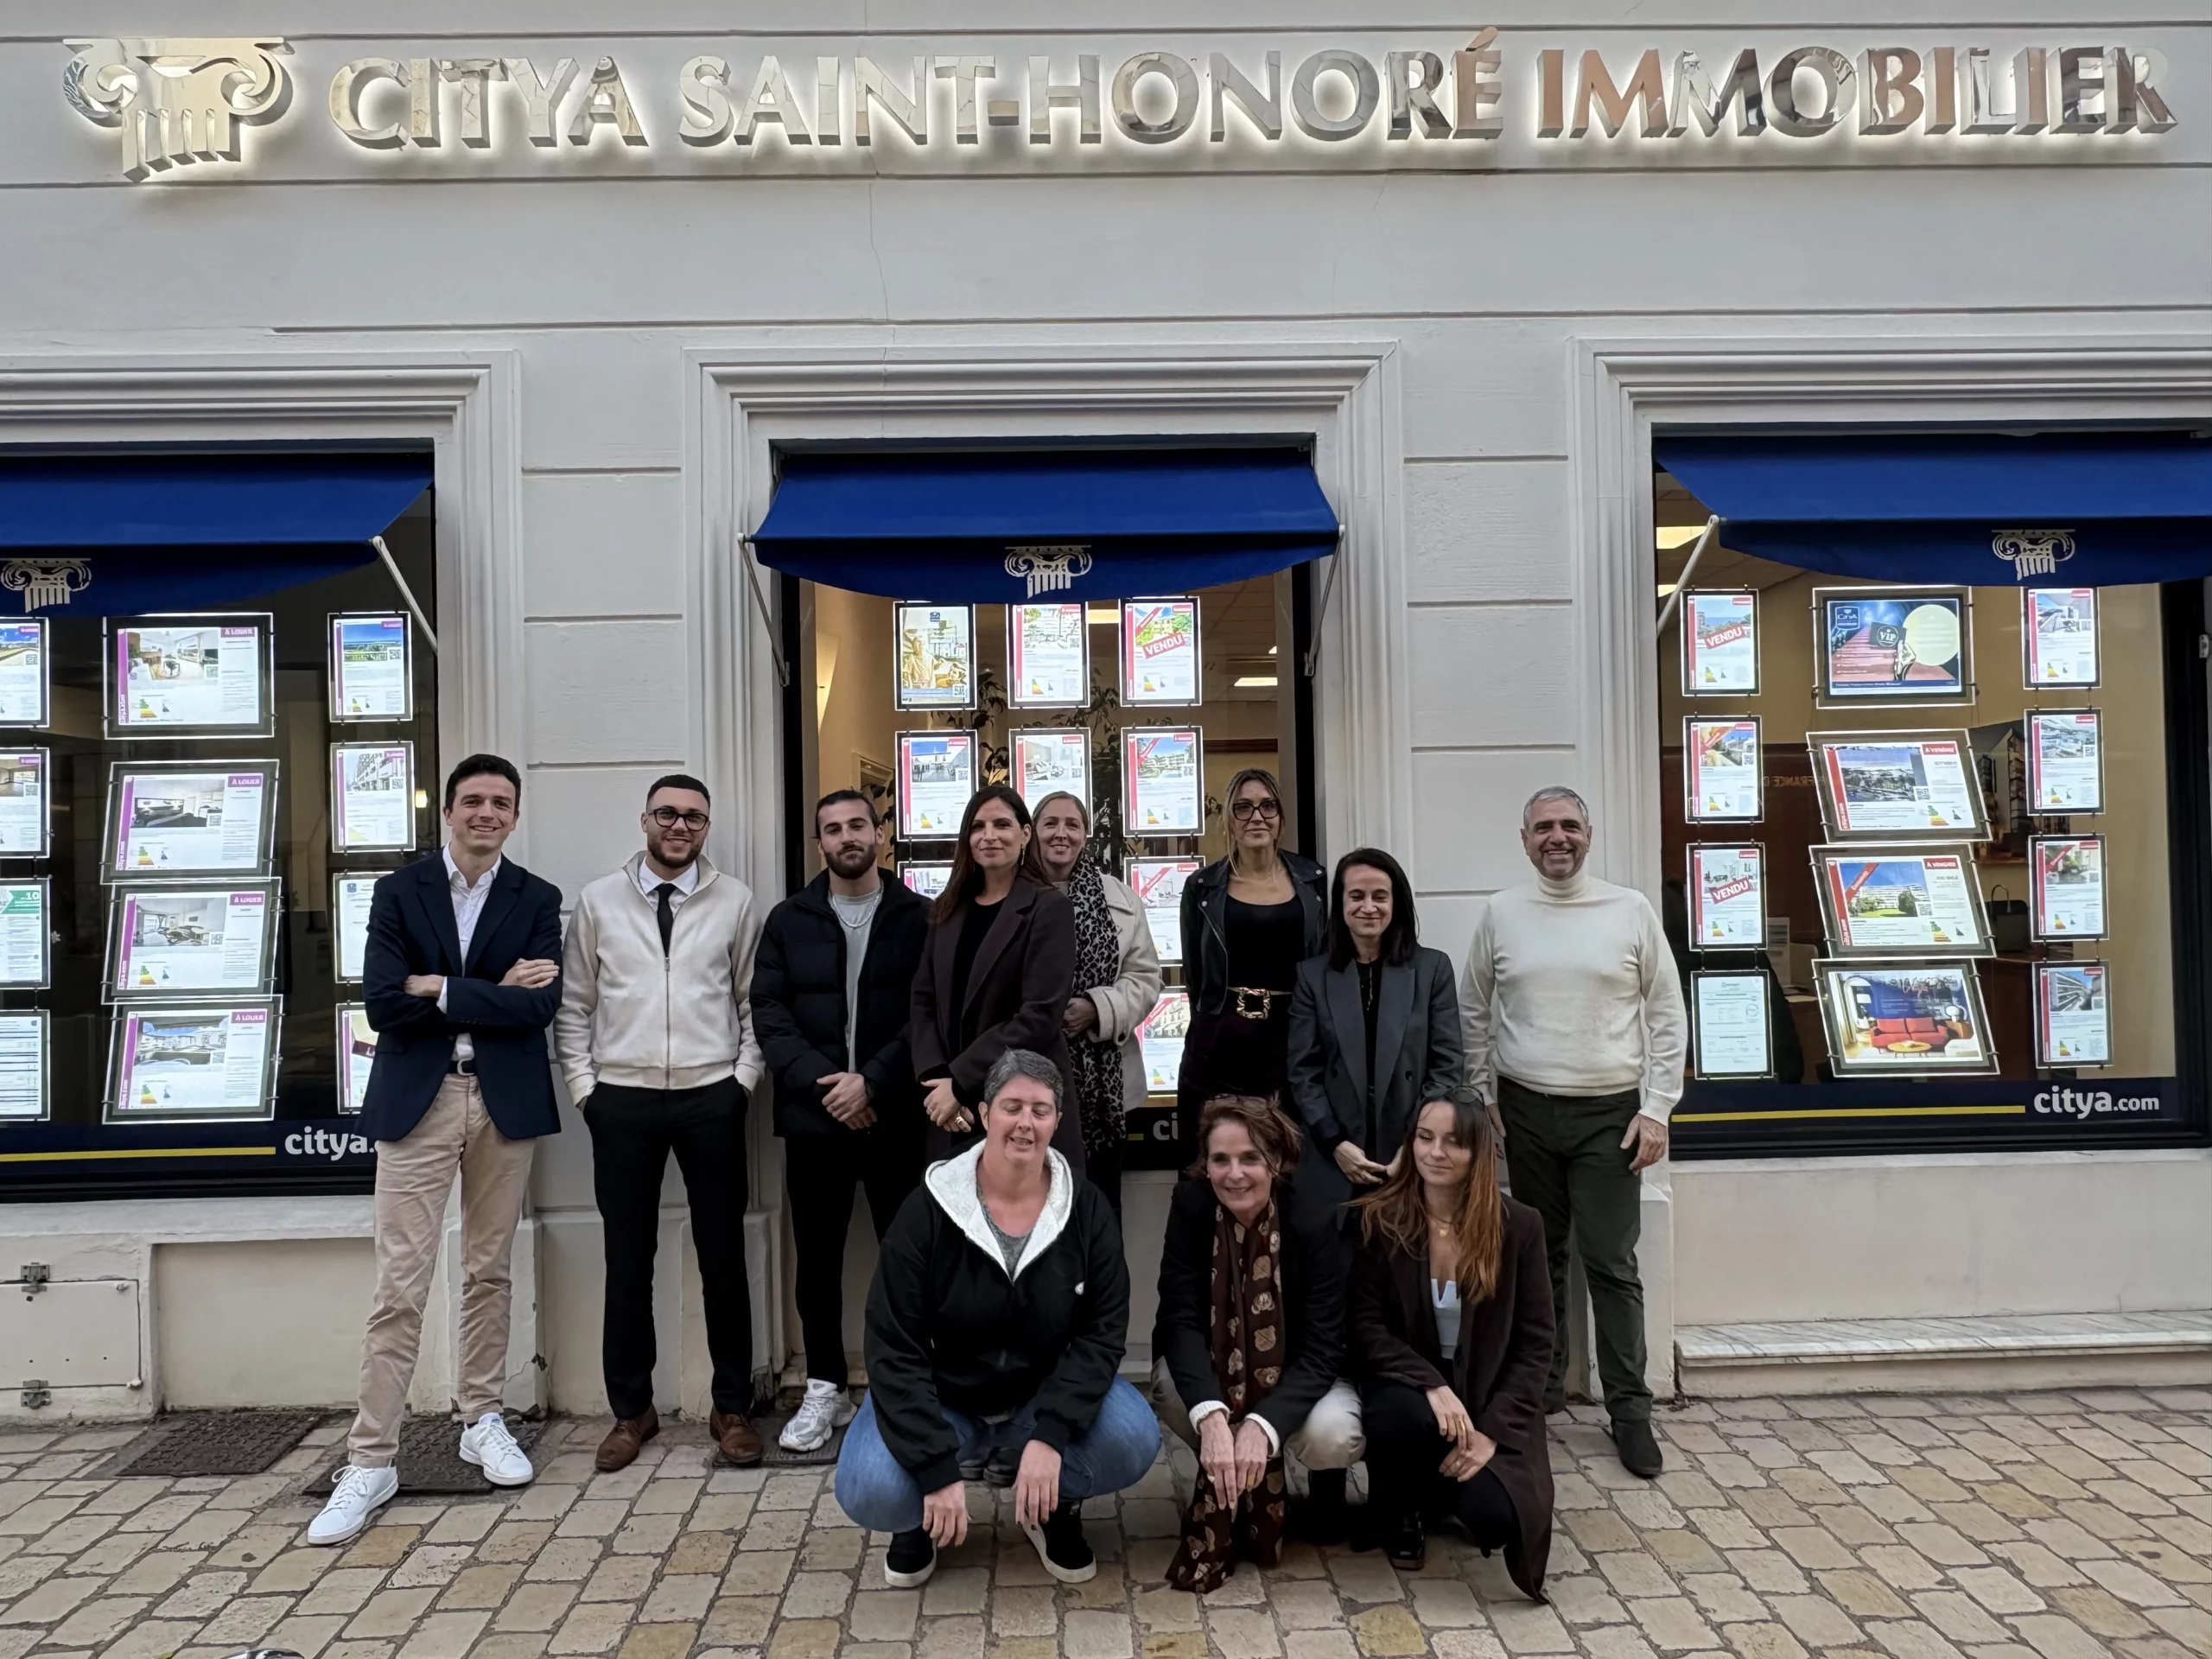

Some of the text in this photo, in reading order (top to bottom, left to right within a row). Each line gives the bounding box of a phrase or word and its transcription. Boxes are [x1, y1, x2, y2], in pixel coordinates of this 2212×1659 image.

[328, 26, 2179, 149] CITYA SAINT-HONORÉ IMMOBILIER
[1145, 634, 1183, 656] VENDU
[1707, 625, 1742, 647] VENDU
[1713, 877, 1749, 901] VENDU
[2033, 1085, 2159, 1119] citya.com
[284, 1125, 375, 1161] citya.
